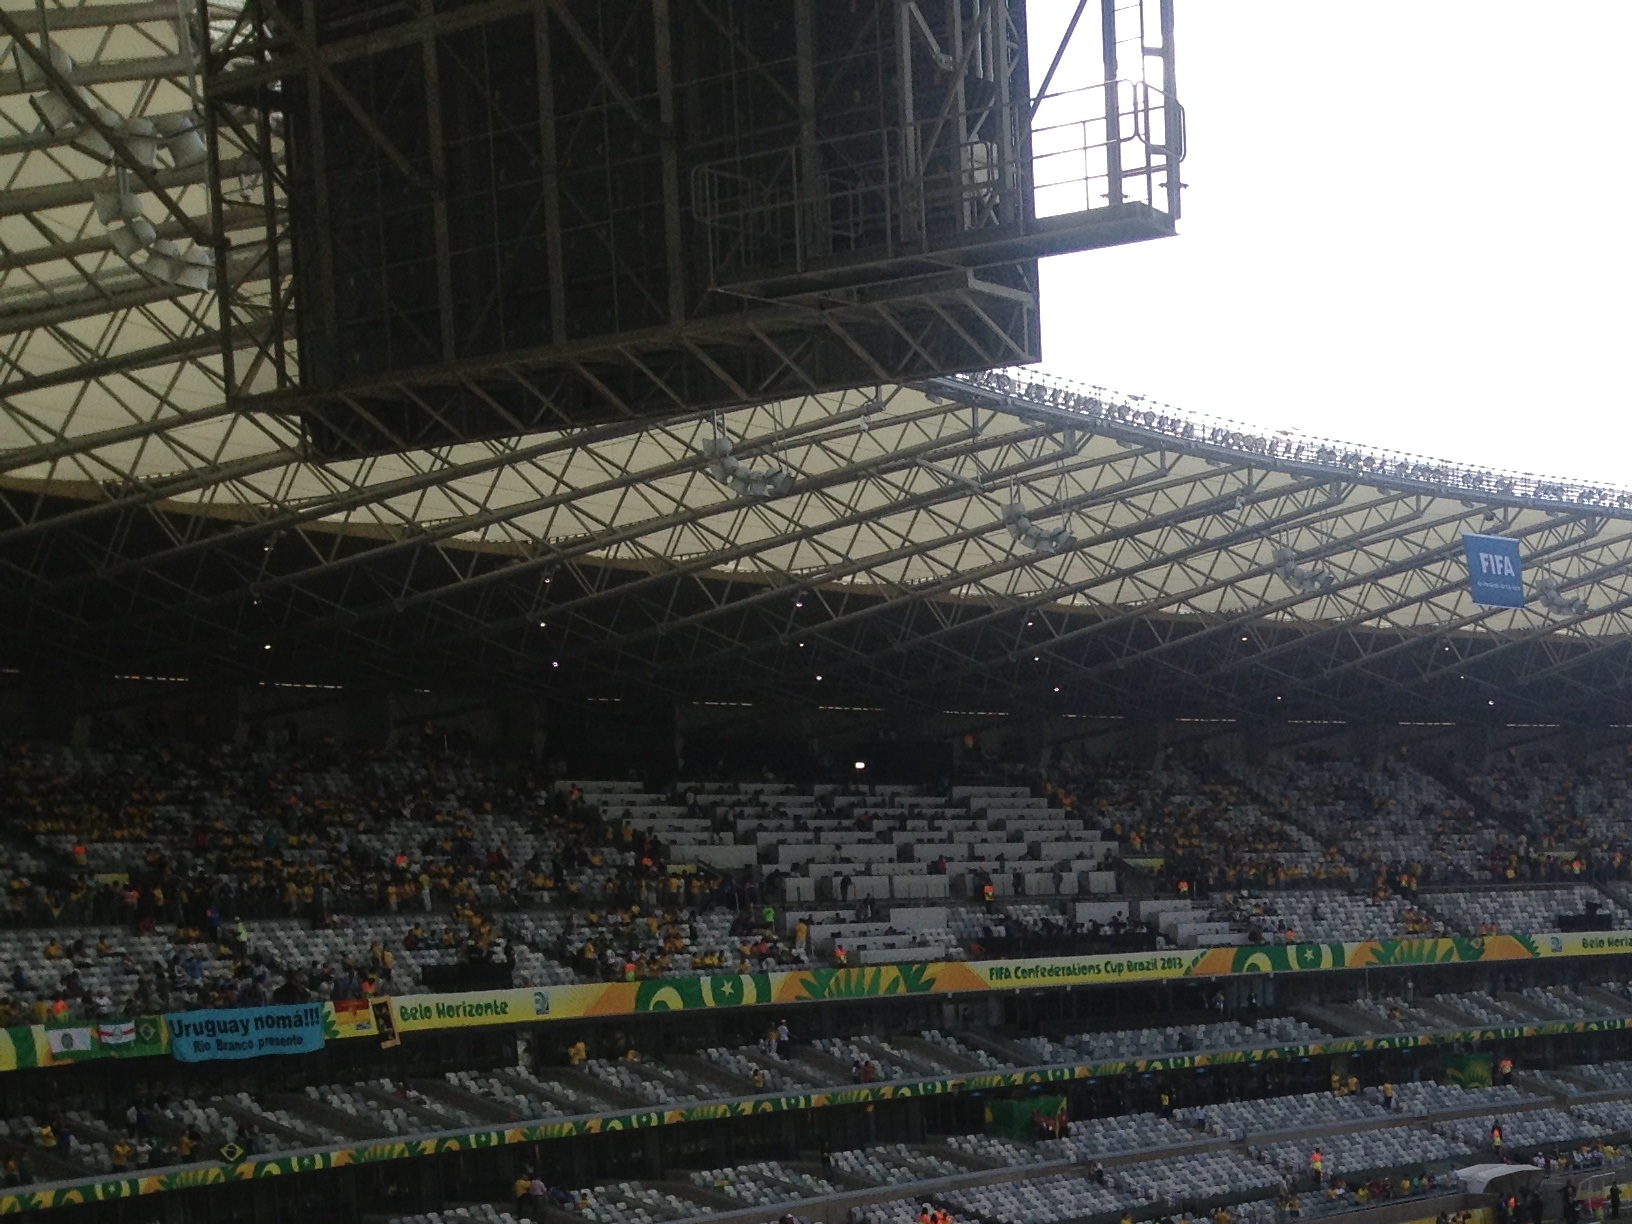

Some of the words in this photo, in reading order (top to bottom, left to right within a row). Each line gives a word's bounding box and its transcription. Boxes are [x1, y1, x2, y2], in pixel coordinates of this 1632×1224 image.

[1479, 552, 1516, 577] FIFA
[1581, 937, 1605, 949] Belo
[989, 966, 1012, 981] FIFA
[1014, 963, 1101, 980] Confederations
[1104, 960, 1124, 976] Cup
[1126, 958, 1158, 973] Brazil
[1160, 956, 1183, 970] 2013
[399, 1003, 432, 1022] Belo
[436, 999, 509, 1020] Horizonte
[169, 1011, 250, 1039] Uruguay
[254, 1007, 321, 1031] nomá!!!
[193, 1039, 211, 1054] Rio
[216, 1037, 253, 1052] Branco
[258, 1034, 303, 1050] presente
